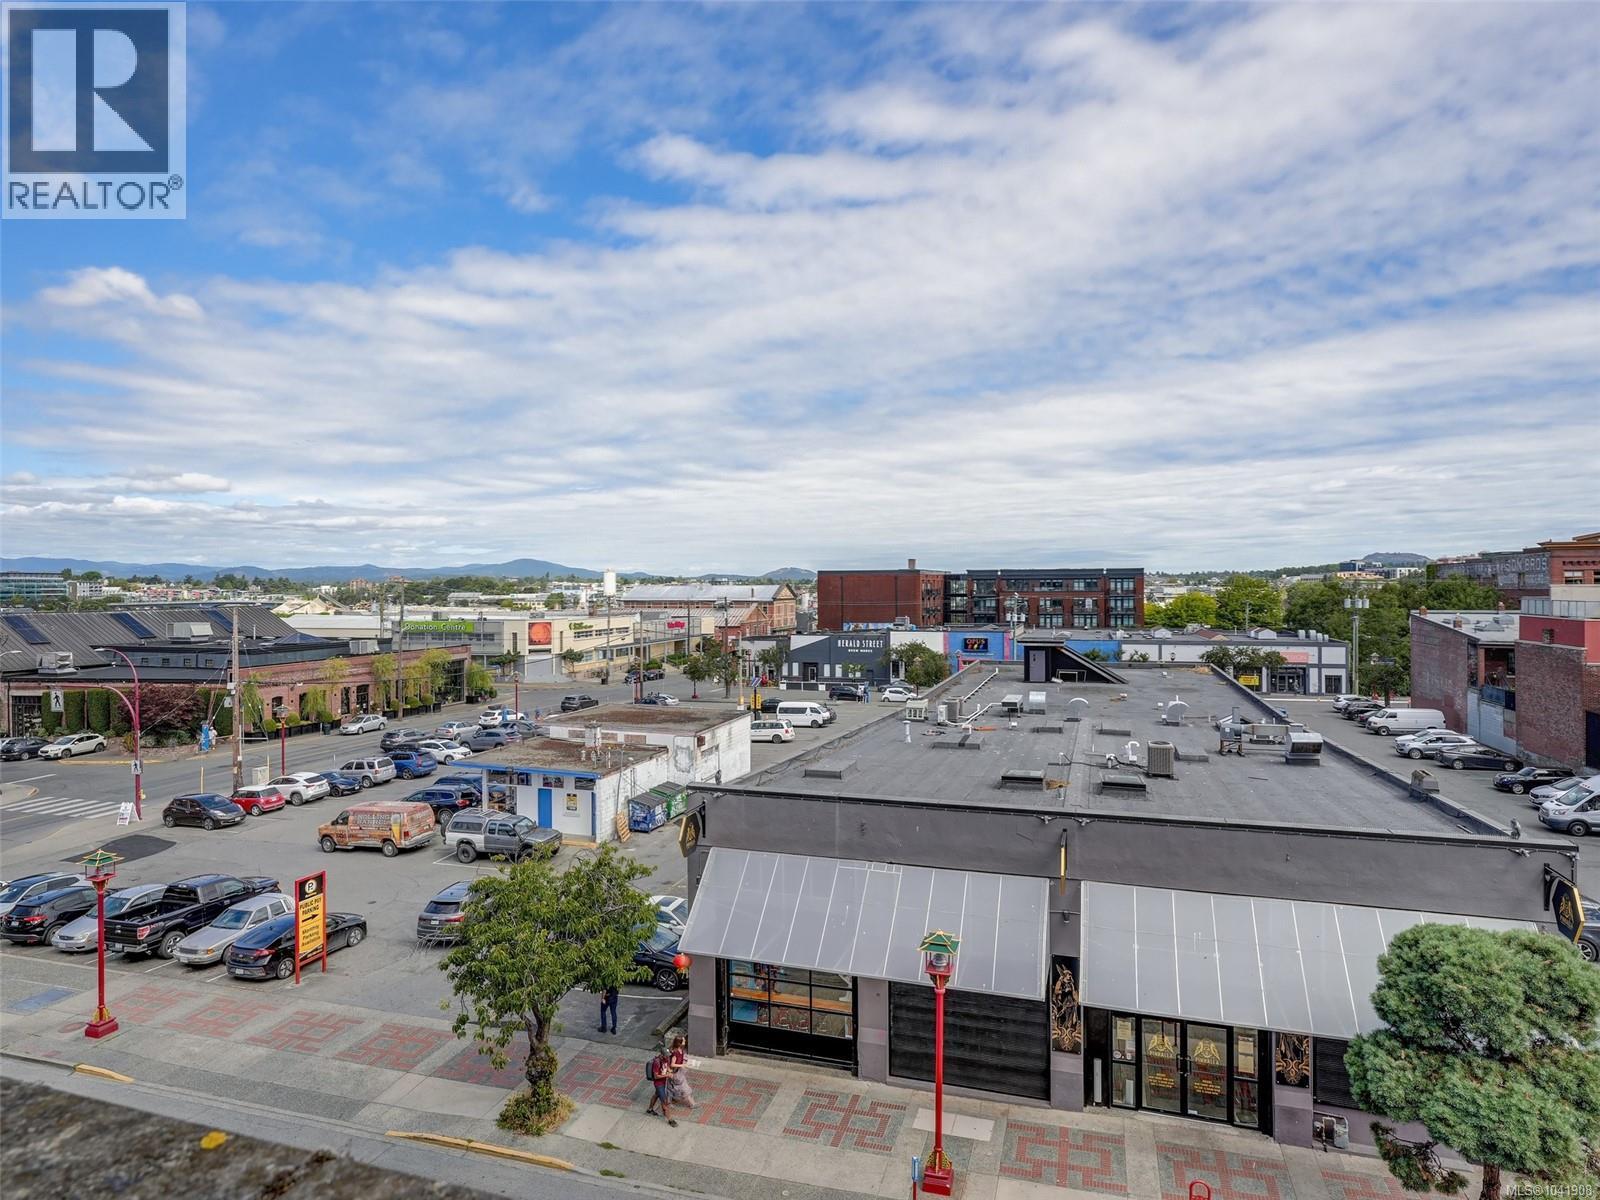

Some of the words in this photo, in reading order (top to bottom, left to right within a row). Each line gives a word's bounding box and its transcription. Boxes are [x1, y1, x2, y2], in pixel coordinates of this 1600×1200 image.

[440, 622, 466, 631] Centre
[837, 639, 860, 648] HERALD
[862, 640, 883, 648] STREET
[299, 899, 314, 910] PUBLIC
[302, 905, 320, 916] PARKING
